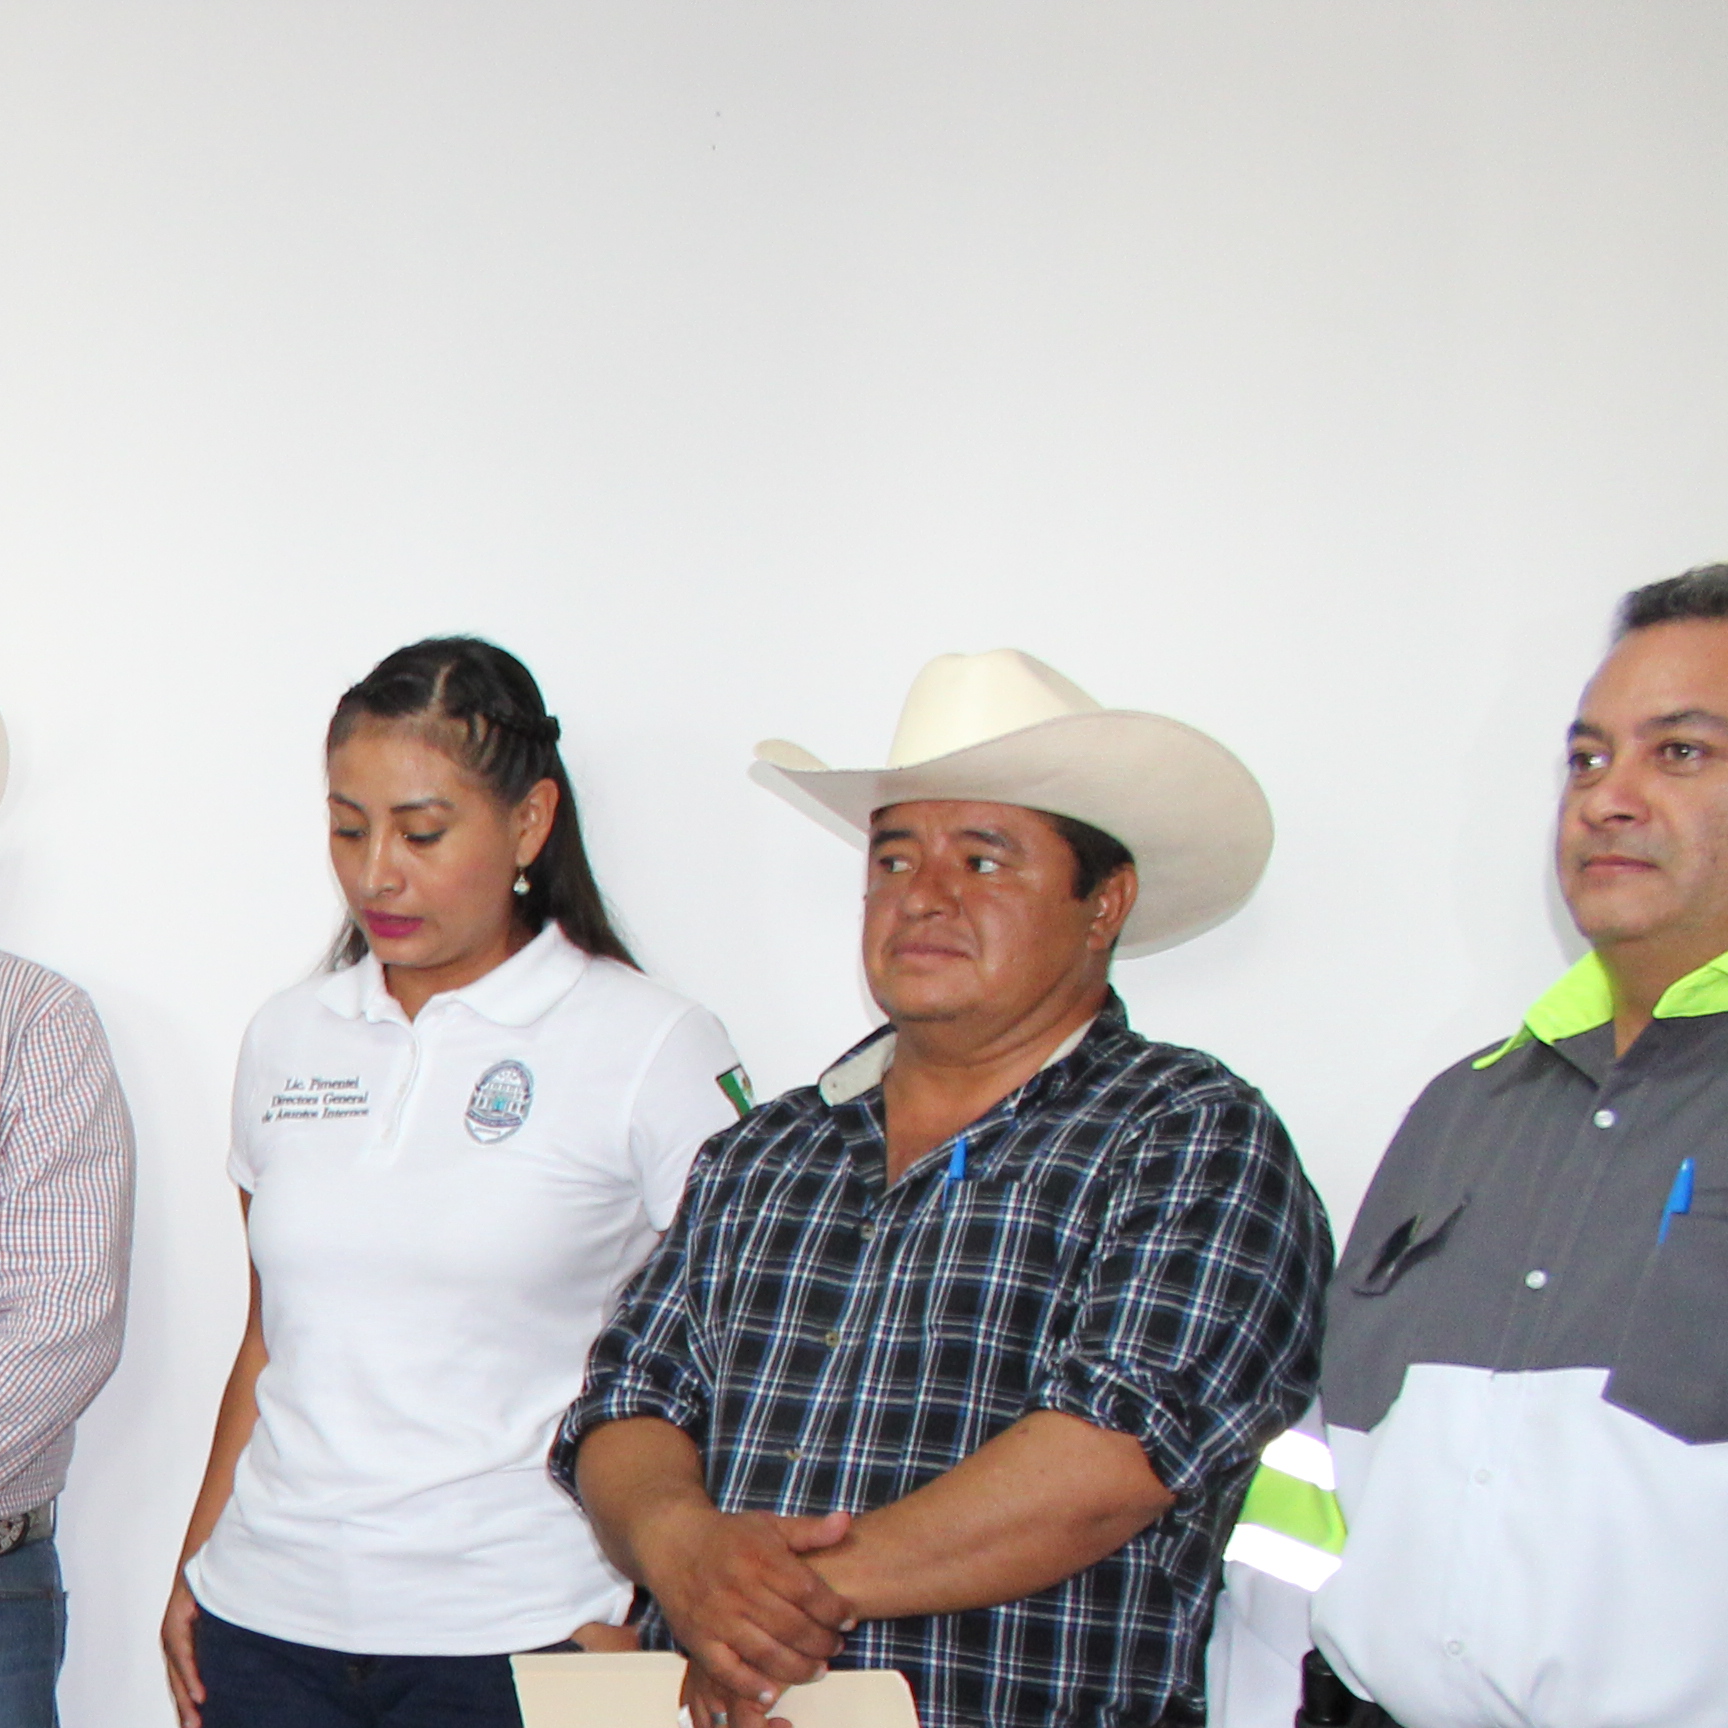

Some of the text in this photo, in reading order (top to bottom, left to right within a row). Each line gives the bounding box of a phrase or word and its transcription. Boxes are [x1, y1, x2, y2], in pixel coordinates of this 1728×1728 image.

[309, 1076, 360, 1091] Pimentel
[271, 1091, 369, 1107] Directora General
